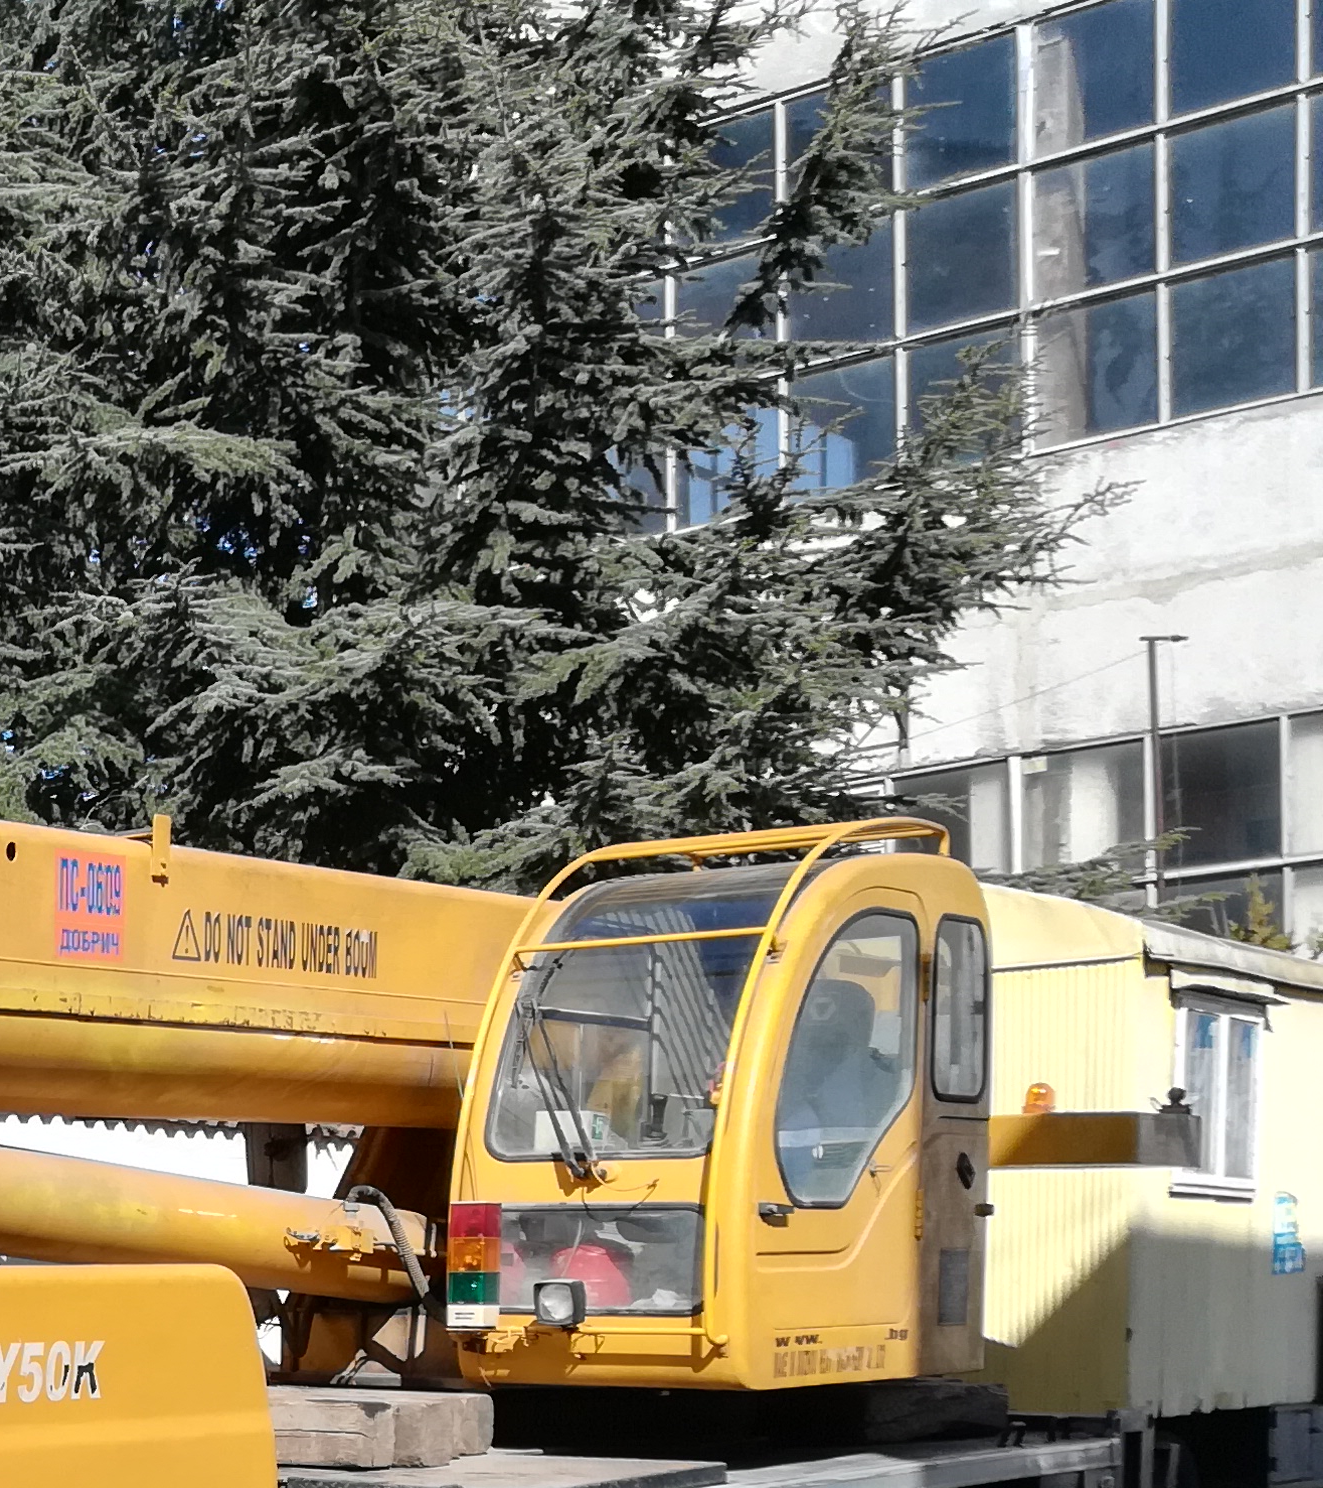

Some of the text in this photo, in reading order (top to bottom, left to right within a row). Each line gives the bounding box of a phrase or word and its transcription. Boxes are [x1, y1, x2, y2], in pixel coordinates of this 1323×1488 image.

[60, 928, 119, 956] ДОБРИЧ
[204, 911, 378, 979] DO NOT STAND UNDER BOOM
